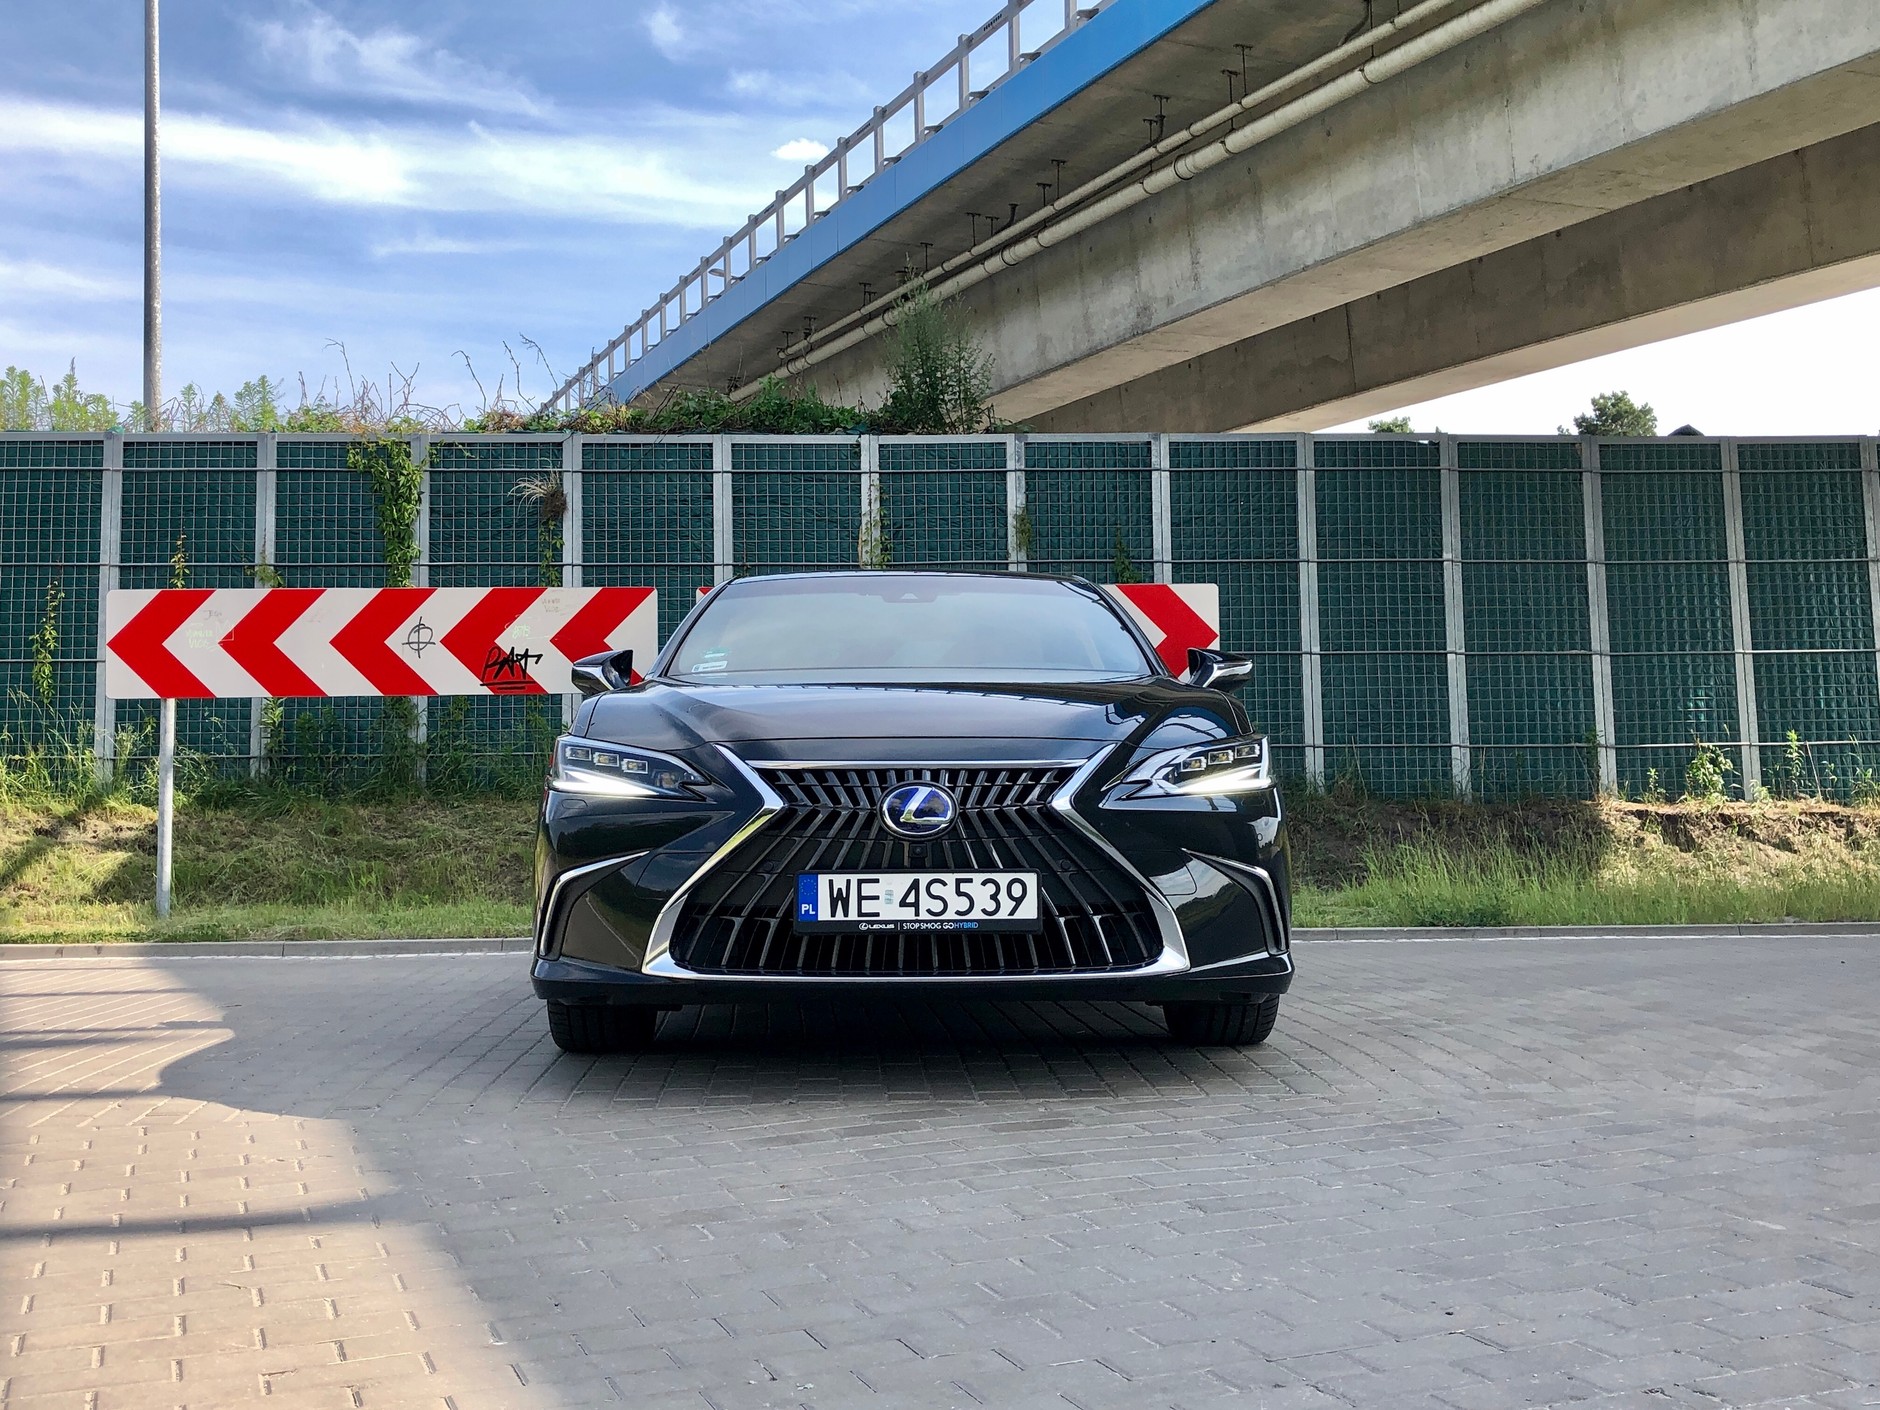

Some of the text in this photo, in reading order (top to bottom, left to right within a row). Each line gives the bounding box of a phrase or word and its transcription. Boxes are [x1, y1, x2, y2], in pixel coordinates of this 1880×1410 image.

[828, 877, 1028, 918] WE 4S539
[801, 904, 816, 915] PL
[903, 922, 920, 930] STOP
[920, 922, 941, 930] SMOG
